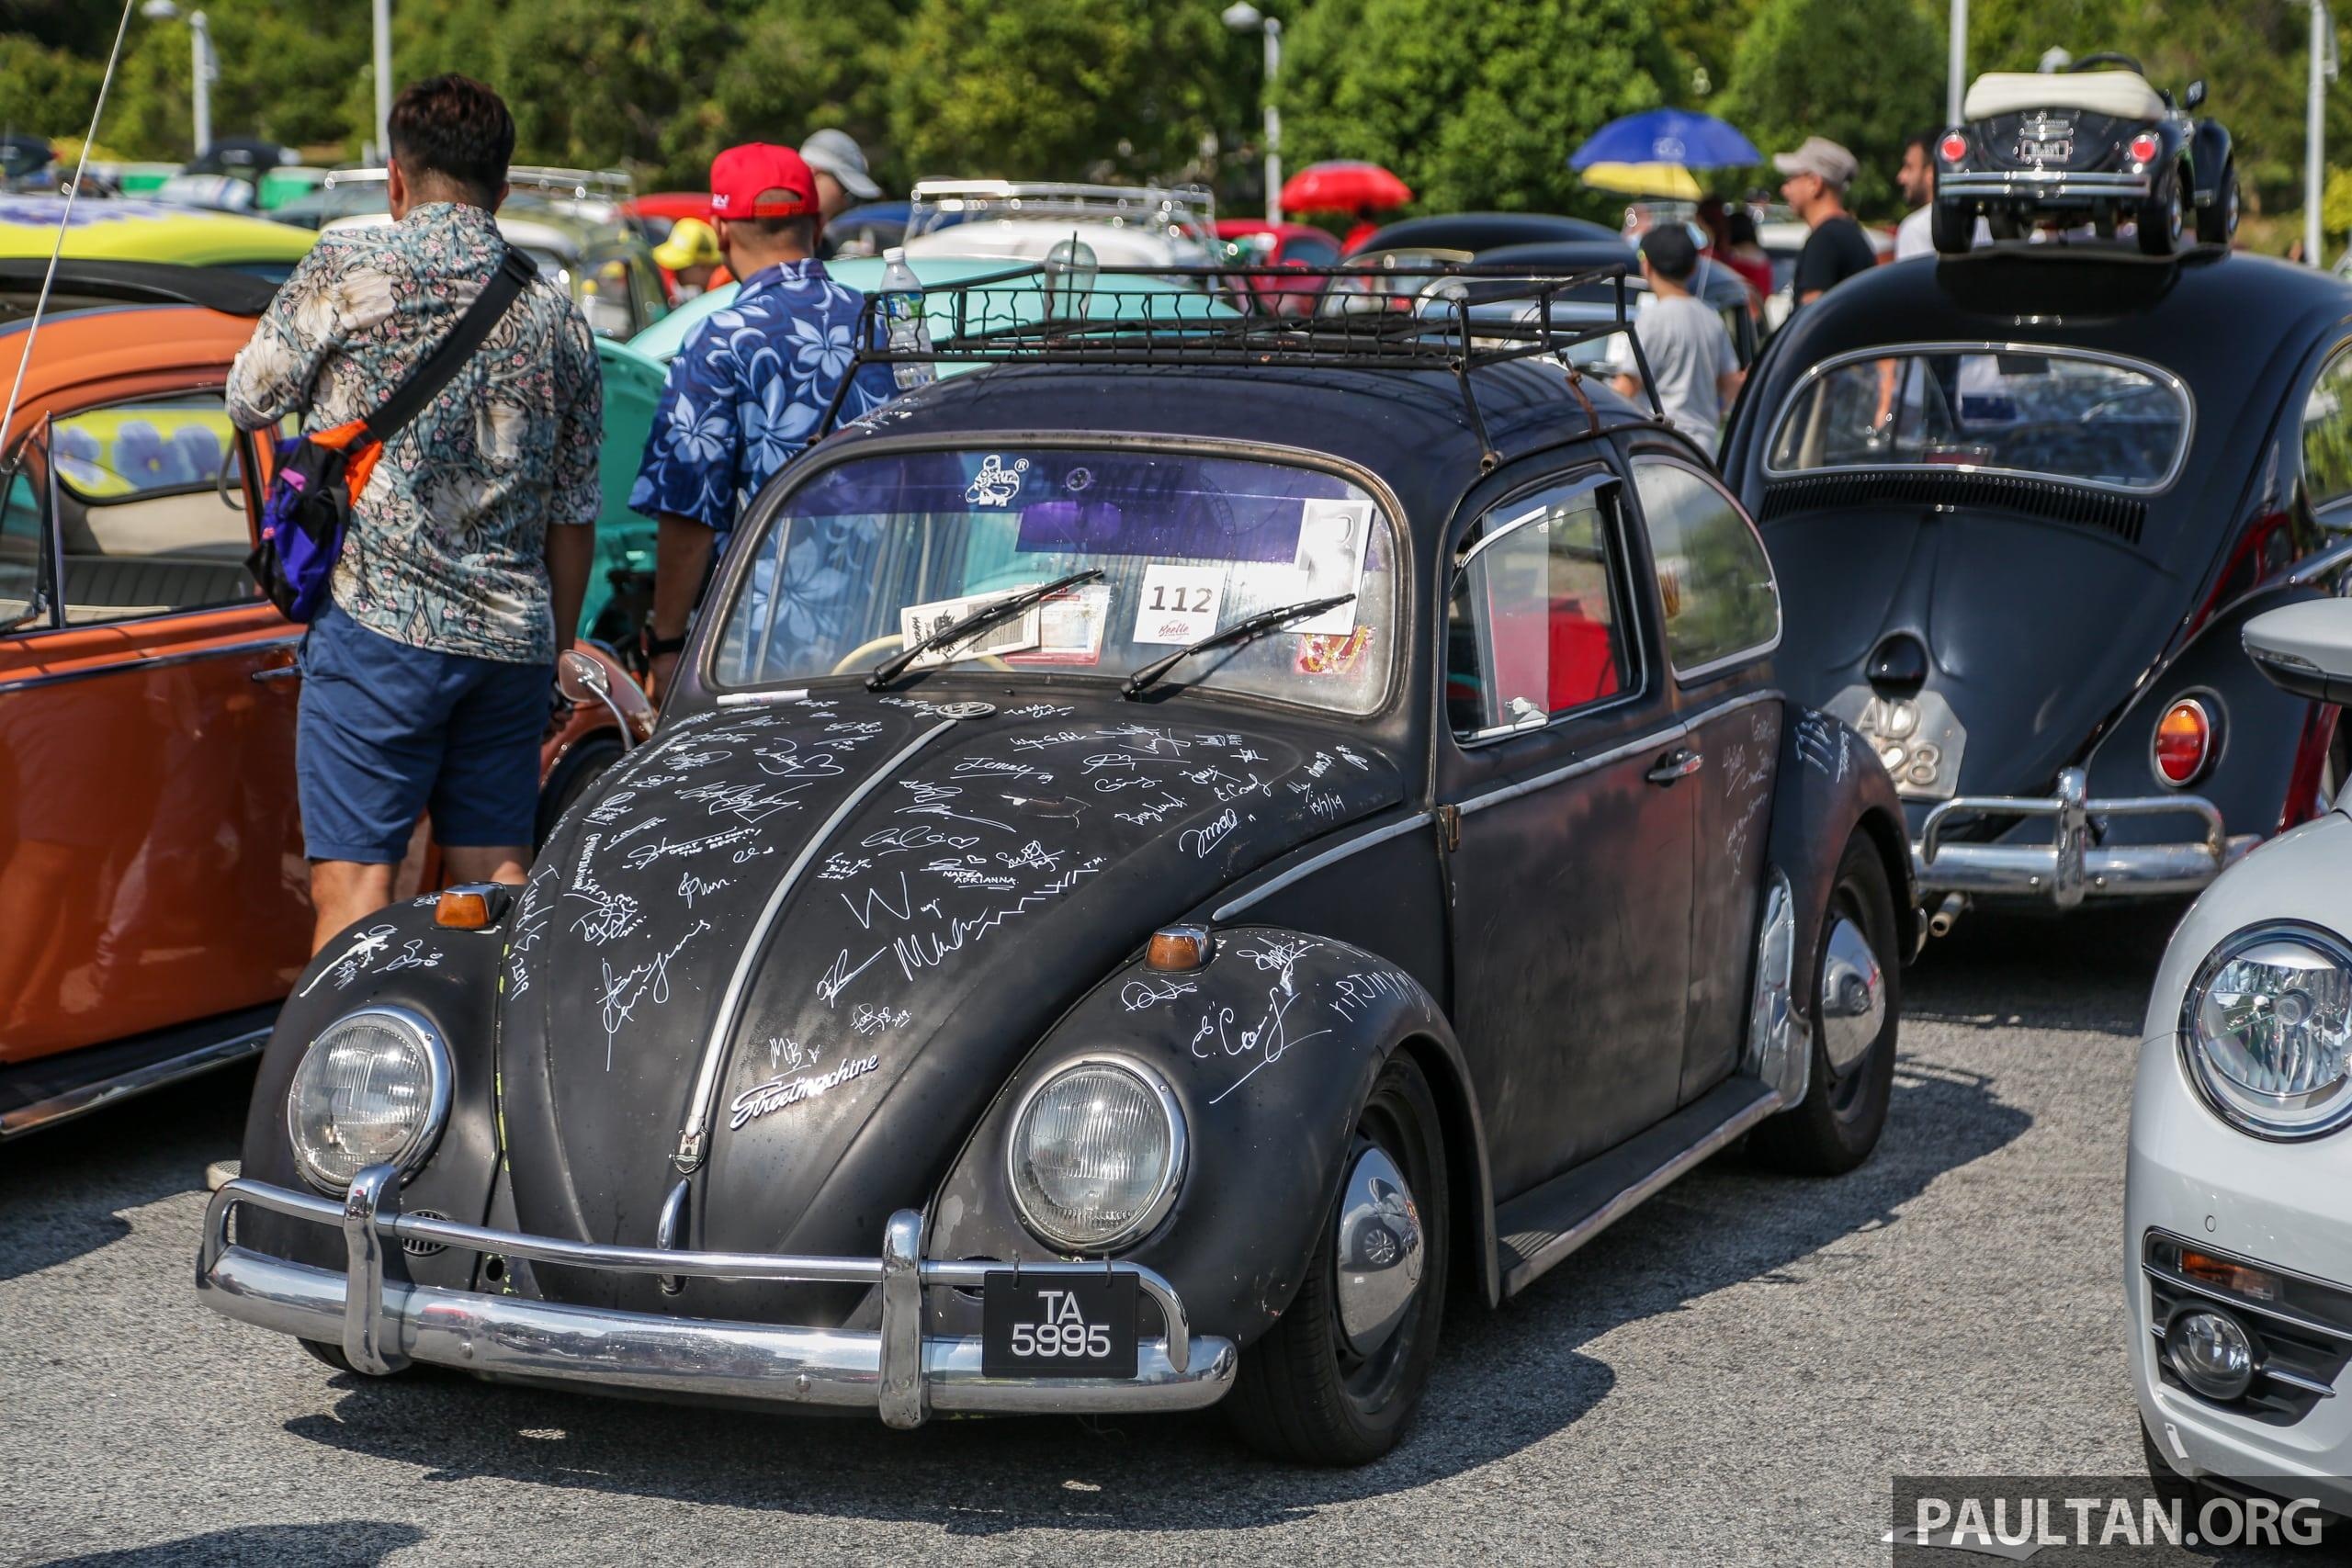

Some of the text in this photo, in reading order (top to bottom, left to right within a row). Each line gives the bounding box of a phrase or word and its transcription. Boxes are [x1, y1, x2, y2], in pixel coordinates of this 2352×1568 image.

[1148, 585, 1214, 613] 112
[1856, 696, 1921, 740] AD
[729, 1054, 879, 1131] Streetmachine
[1037, 1291, 1084, 1325] TA
[1011, 1323, 1111, 1358] 5995
